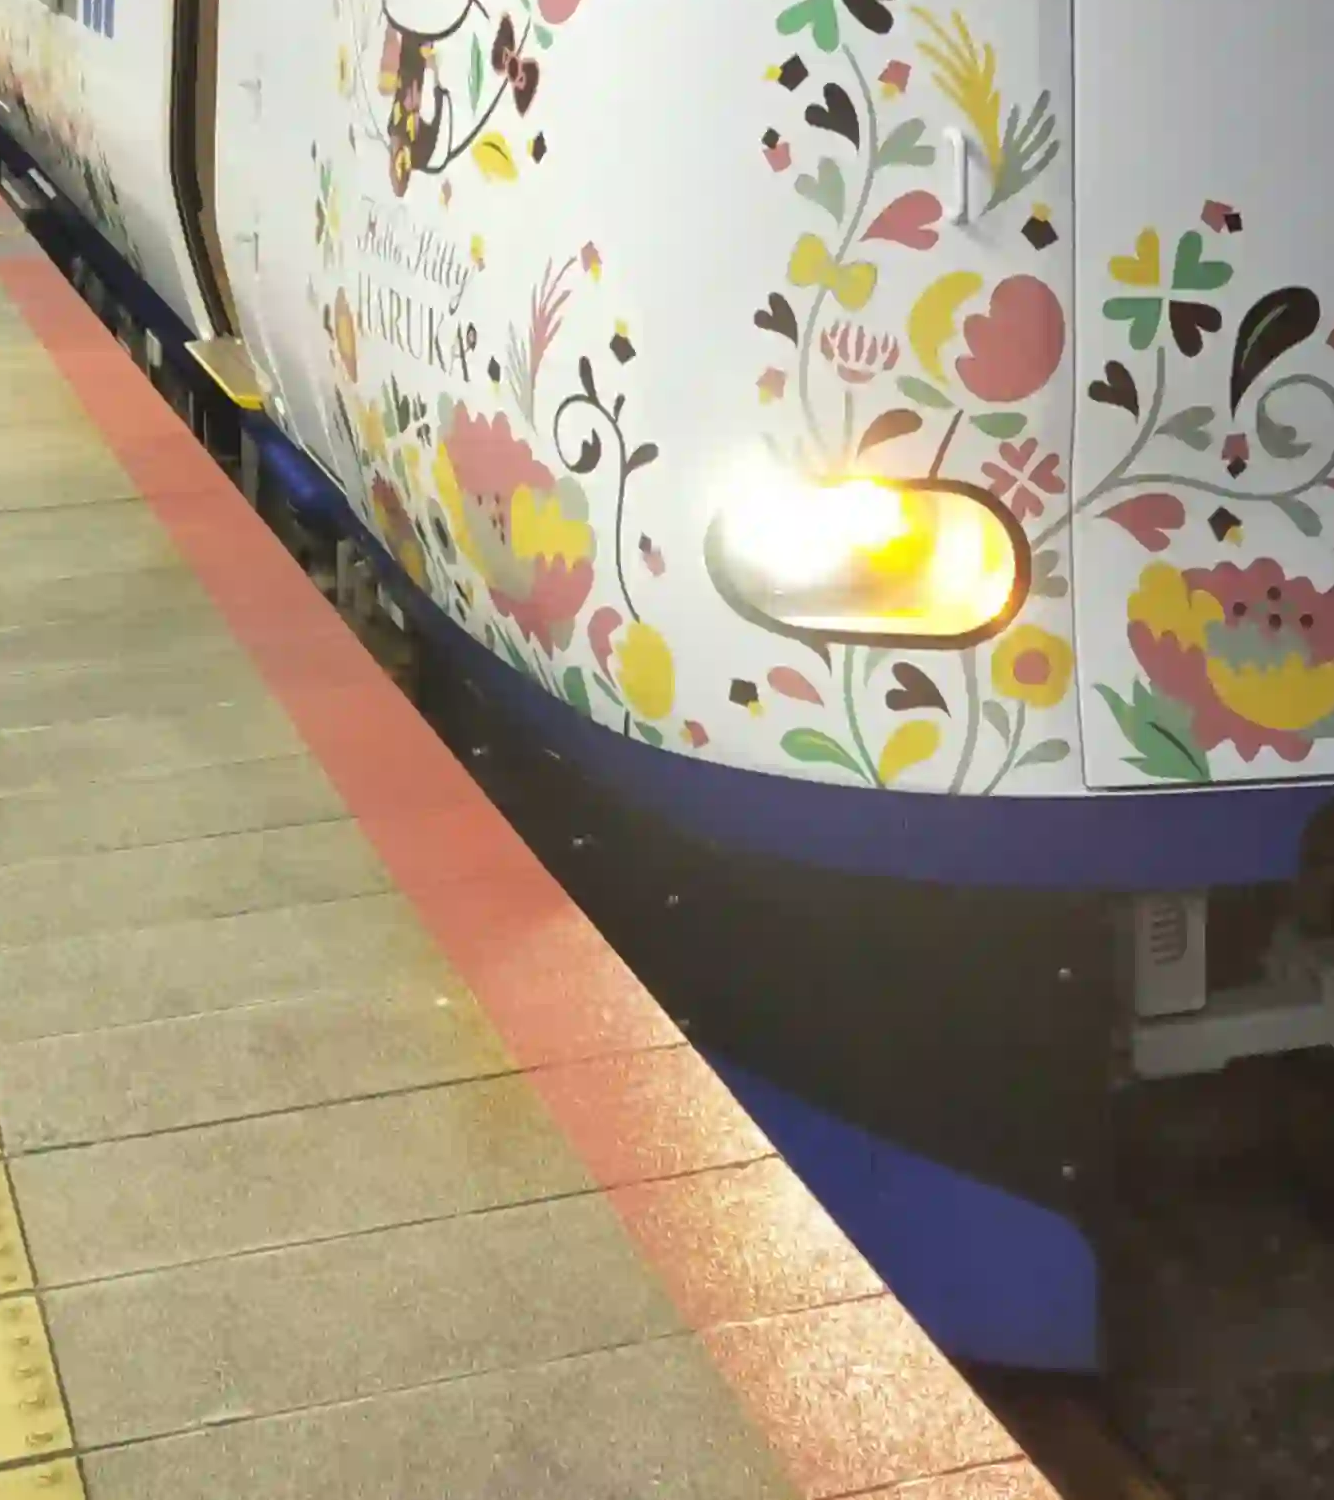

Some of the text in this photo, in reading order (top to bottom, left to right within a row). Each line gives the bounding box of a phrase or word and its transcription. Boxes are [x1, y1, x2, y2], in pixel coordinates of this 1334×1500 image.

[356, 198, 473, 316] Hello Kitty
[357, 270, 471, 382] HARUKA
